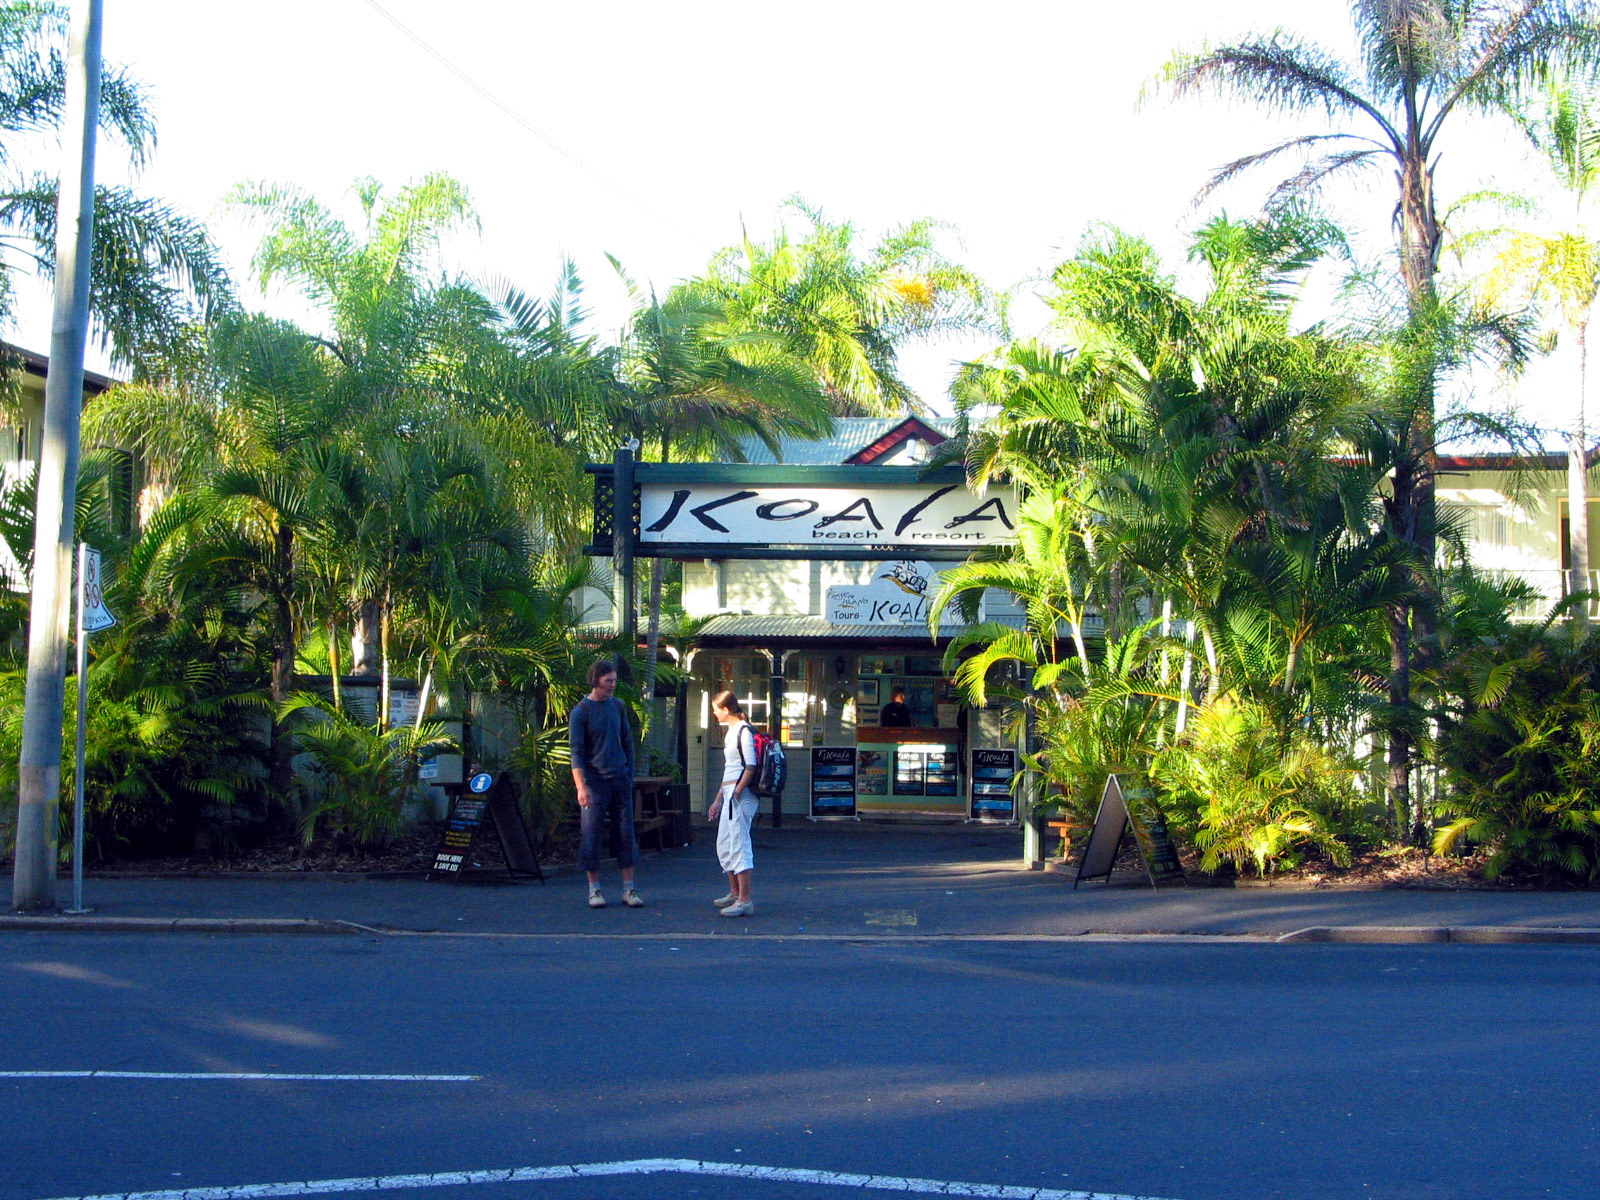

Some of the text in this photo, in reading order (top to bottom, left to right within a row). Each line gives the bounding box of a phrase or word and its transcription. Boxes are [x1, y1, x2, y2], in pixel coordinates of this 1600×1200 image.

[644, 485, 1014, 537] KOALA
[812, 529, 986, 541] beach resort
[833, 610, 860, 620] Tours
